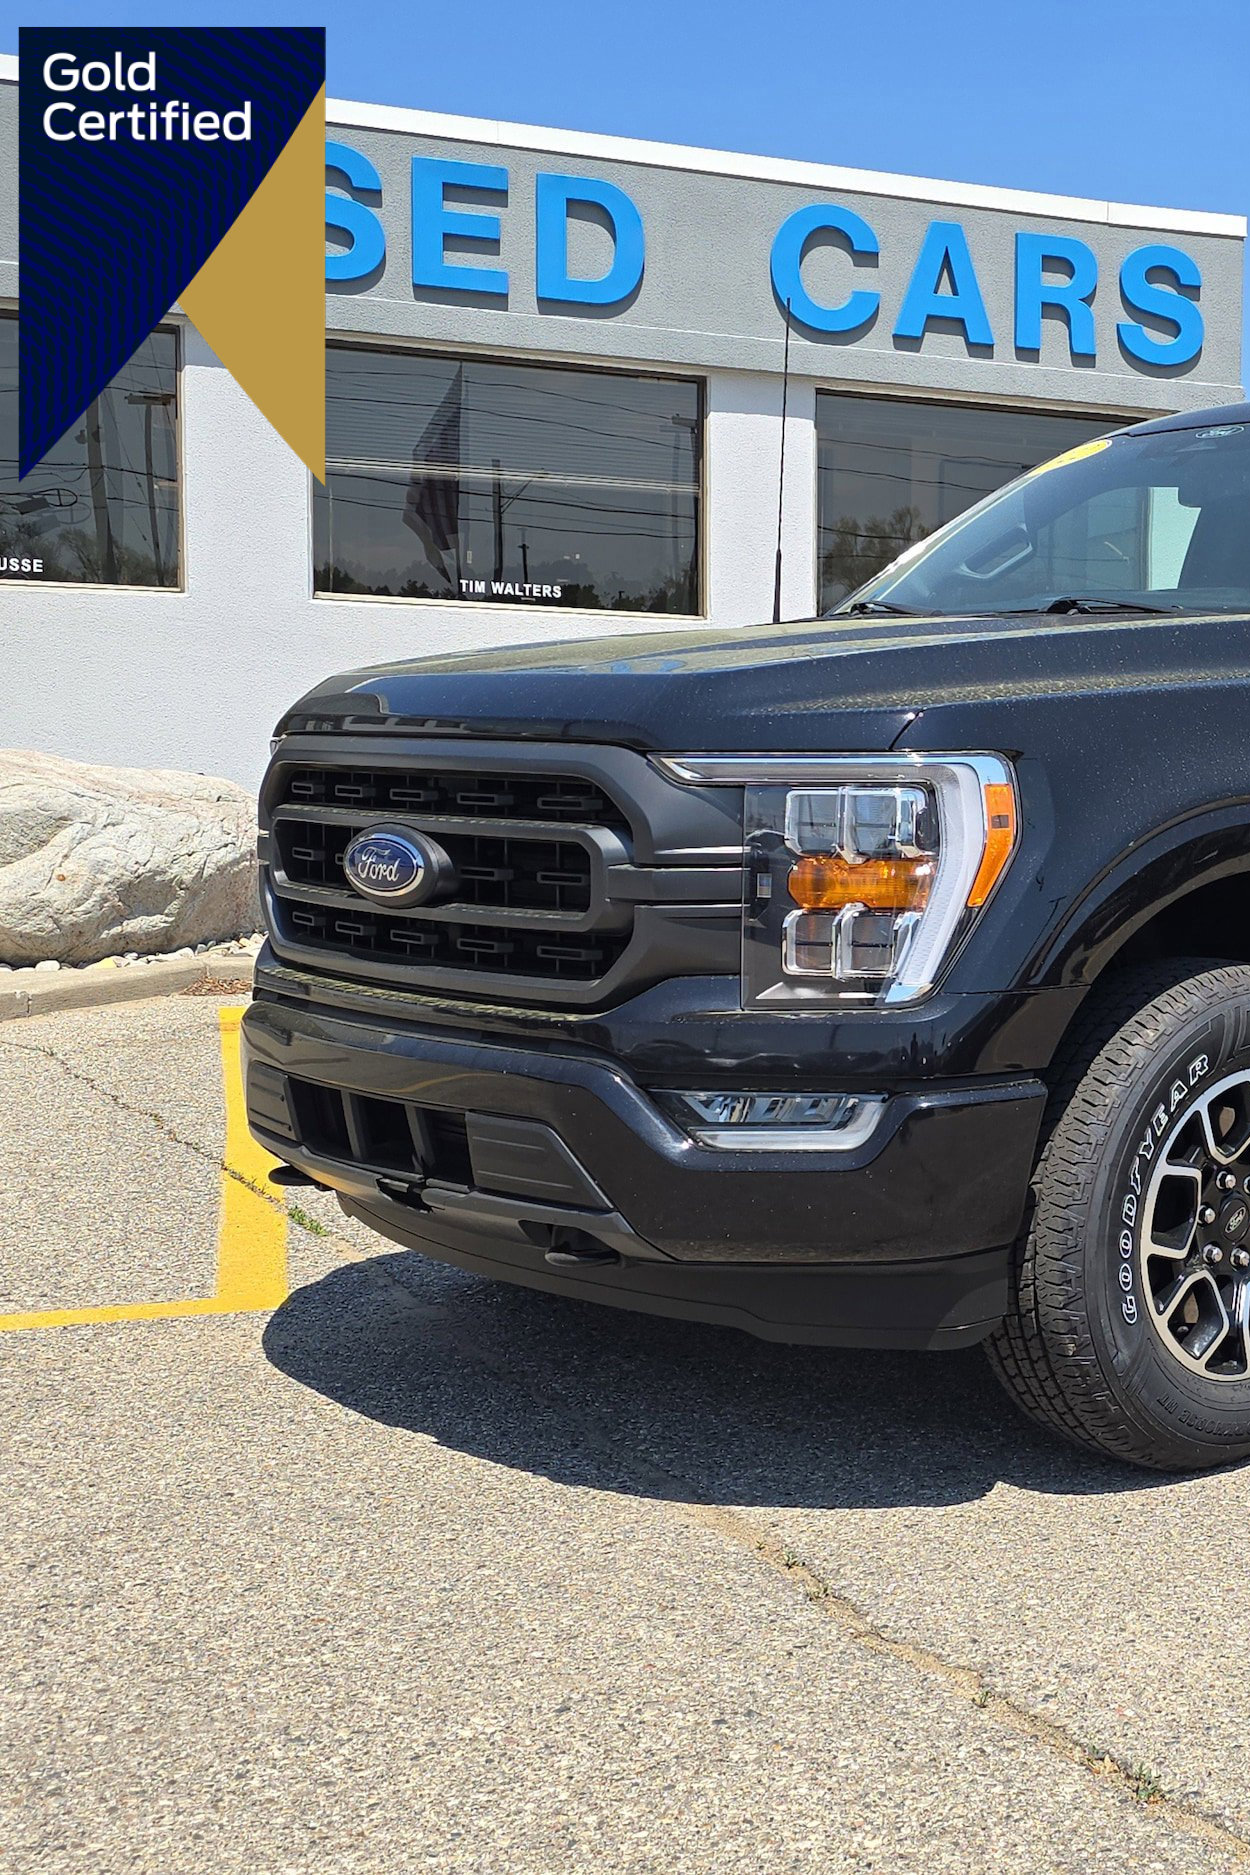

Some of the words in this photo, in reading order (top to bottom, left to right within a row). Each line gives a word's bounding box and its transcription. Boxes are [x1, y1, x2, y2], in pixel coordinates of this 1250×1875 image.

[770, 203, 1205, 365] CARS
[460, 579, 486, 594] TIM
[491, 581, 562, 598] WALTERS
[358, 846, 401, 882] Ford
[1118, 1054, 1209, 1324] GOODYEAR
